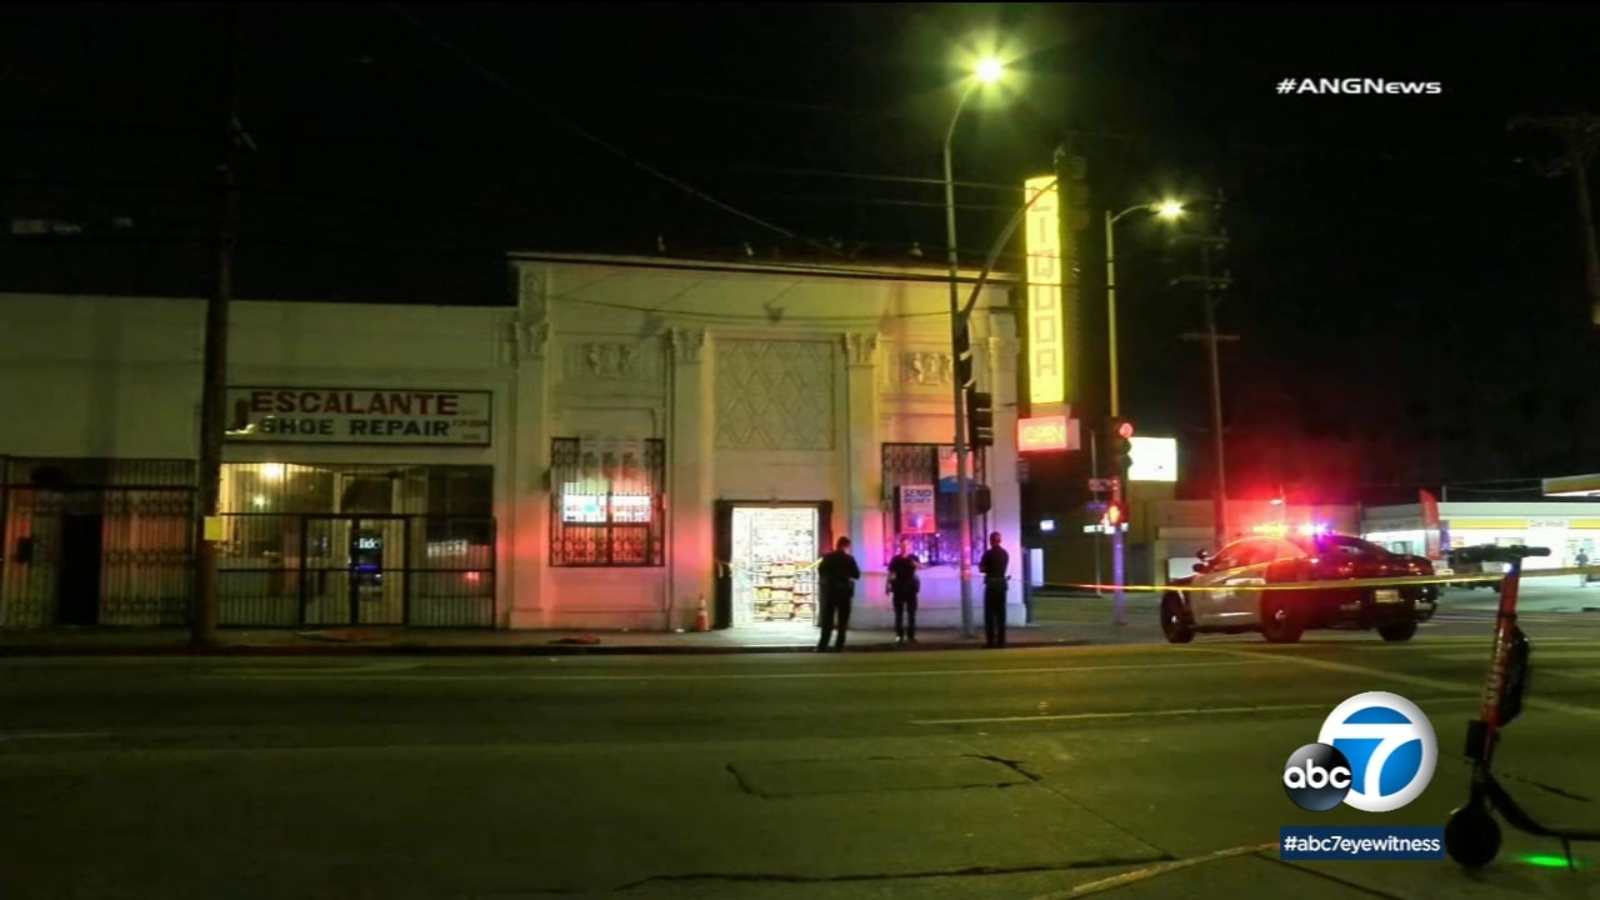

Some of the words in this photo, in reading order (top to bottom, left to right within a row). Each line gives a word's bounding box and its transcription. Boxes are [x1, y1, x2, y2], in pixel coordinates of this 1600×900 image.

[1031, 187, 1058, 377] LIQUOR
[251, 391, 459, 416] ESCALANTE
[260, 418, 335, 436] SHOE
[349, 419, 450, 437] REPAIR
[904, 489, 932, 497] SEND
